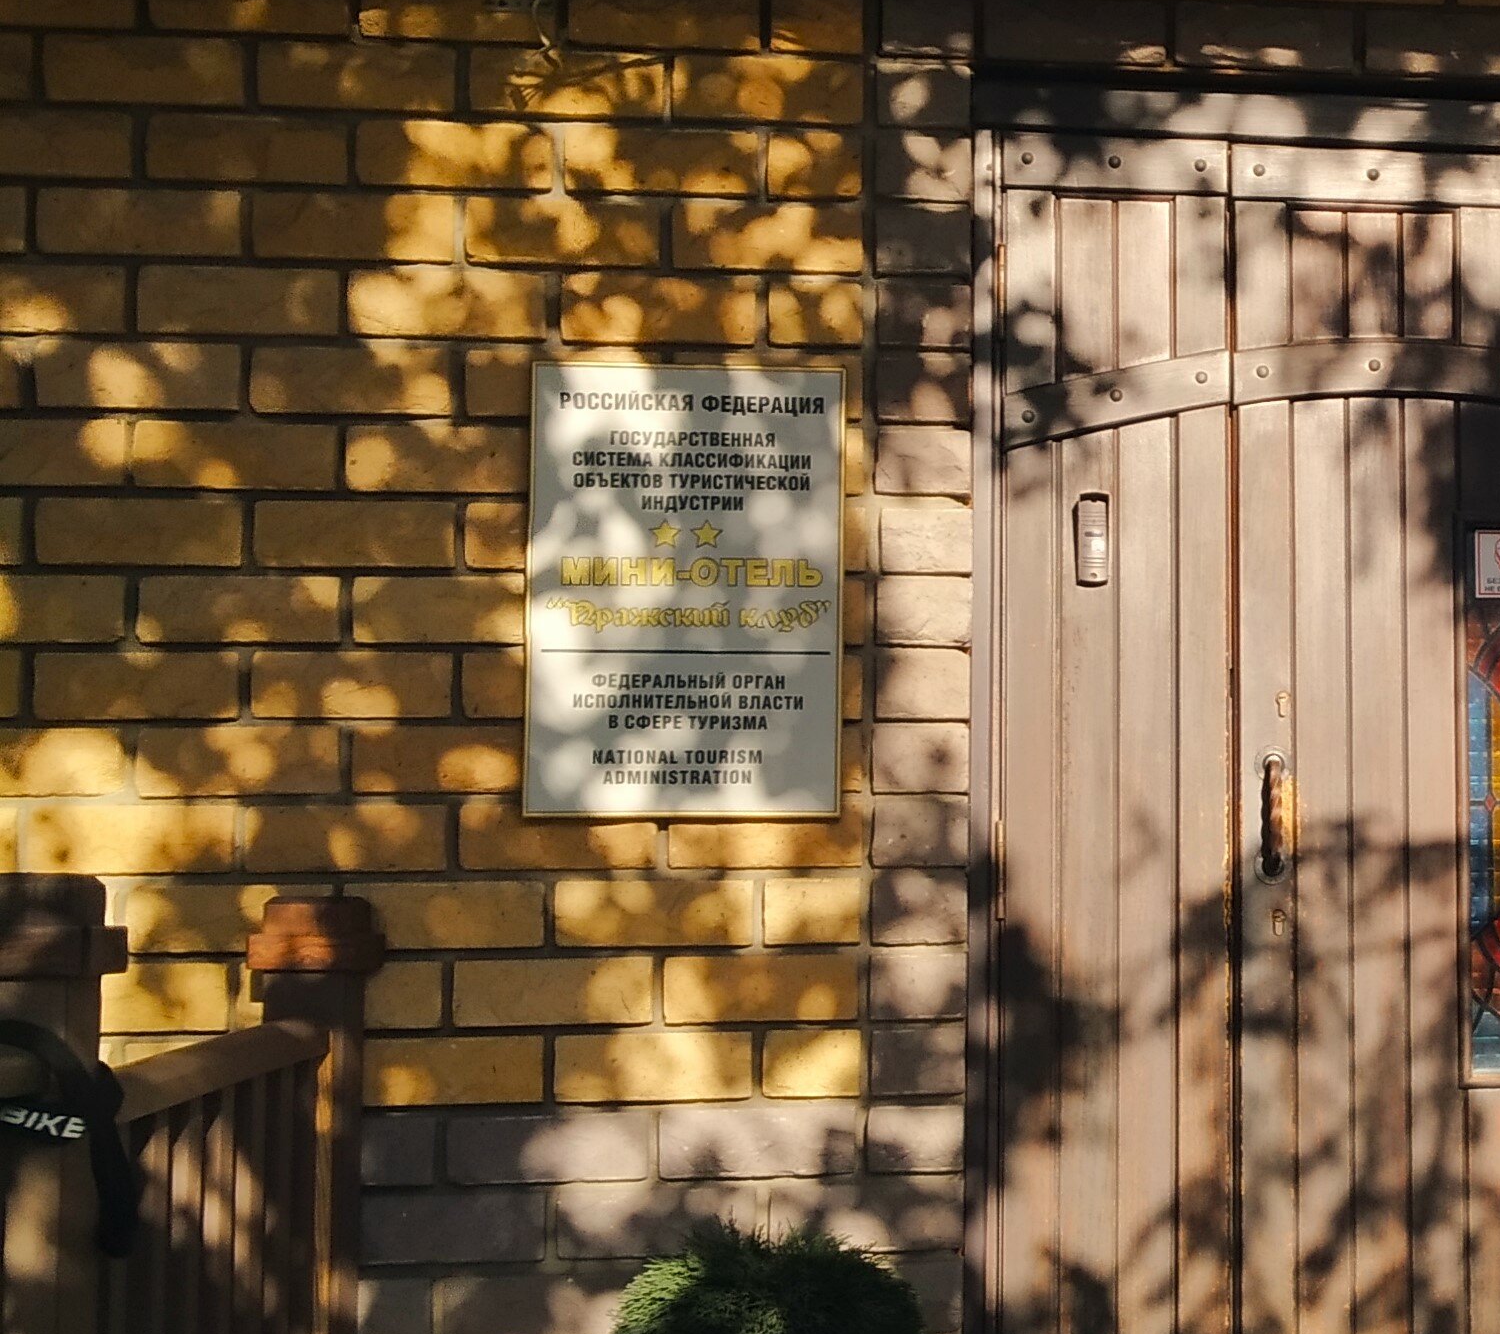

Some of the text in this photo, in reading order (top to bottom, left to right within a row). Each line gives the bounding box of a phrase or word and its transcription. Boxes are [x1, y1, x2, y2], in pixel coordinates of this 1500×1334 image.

[559, 391, 824, 416] РОССИЙСКАЯ ФЕДЕРАЦИЯ
[610, 431, 775, 448] ГОСУДАРСТВЕННАЯ
[572, 451, 811, 471] СИСТЕМА КЛАССИФИКАЦИИ
[573, 473, 810, 491] ОБЪЕКТОВ ТУРИСТИЧЕСКОЙ
[642, 495, 743, 512] ИНДУСТРИИ
[561, 556, 823, 587] МИНИ-ОТЕЛЬ
[592, 673, 785, 690] ФЕДЕРАЛЬНЫЙ ОРГАН
[573, 693, 803, 710] ИСПОЛНИТЕЛЬНОЙ ВЛАСТИ
[609, 714, 767, 730] В СФЕРЕ ТУРИЗМА
[593, 750, 762, 764] NATIONAL TOURISM
[603, 770, 752, 785] ADMINISTRATION
